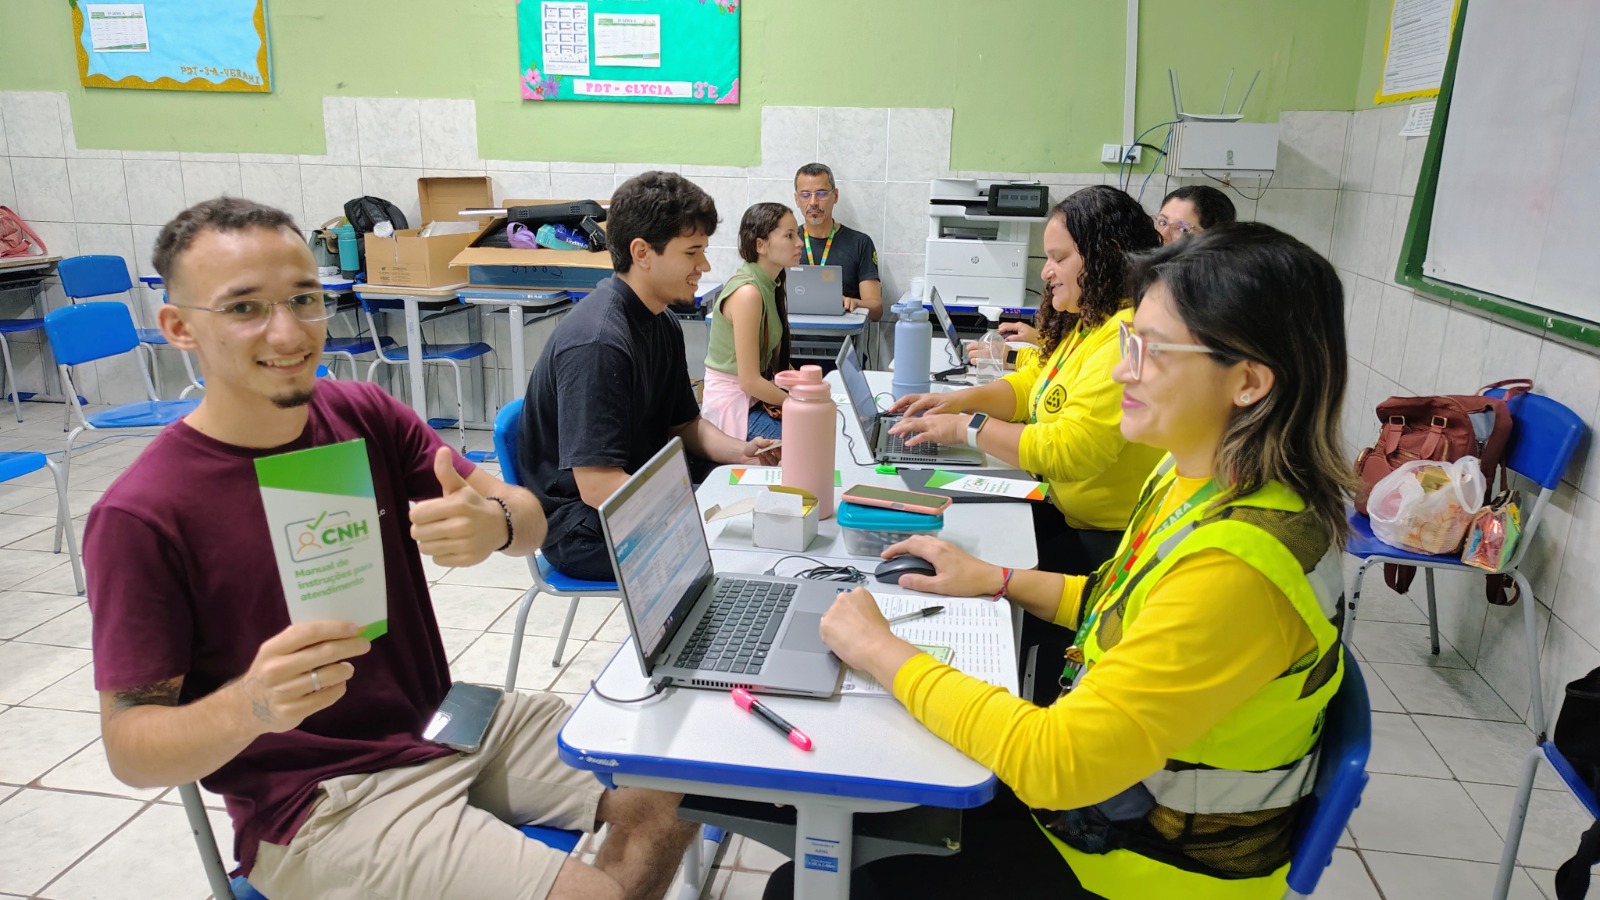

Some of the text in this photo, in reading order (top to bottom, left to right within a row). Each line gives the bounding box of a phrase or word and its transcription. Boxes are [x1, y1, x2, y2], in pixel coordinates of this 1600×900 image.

[586, 82, 612, 93] PDT
[321, 519, 369, 545] CNH
[295, 559, 349, 578] Manual de
[297, 562, 373, 590] instruções para
[300, 577, 365, 600] atendimento
